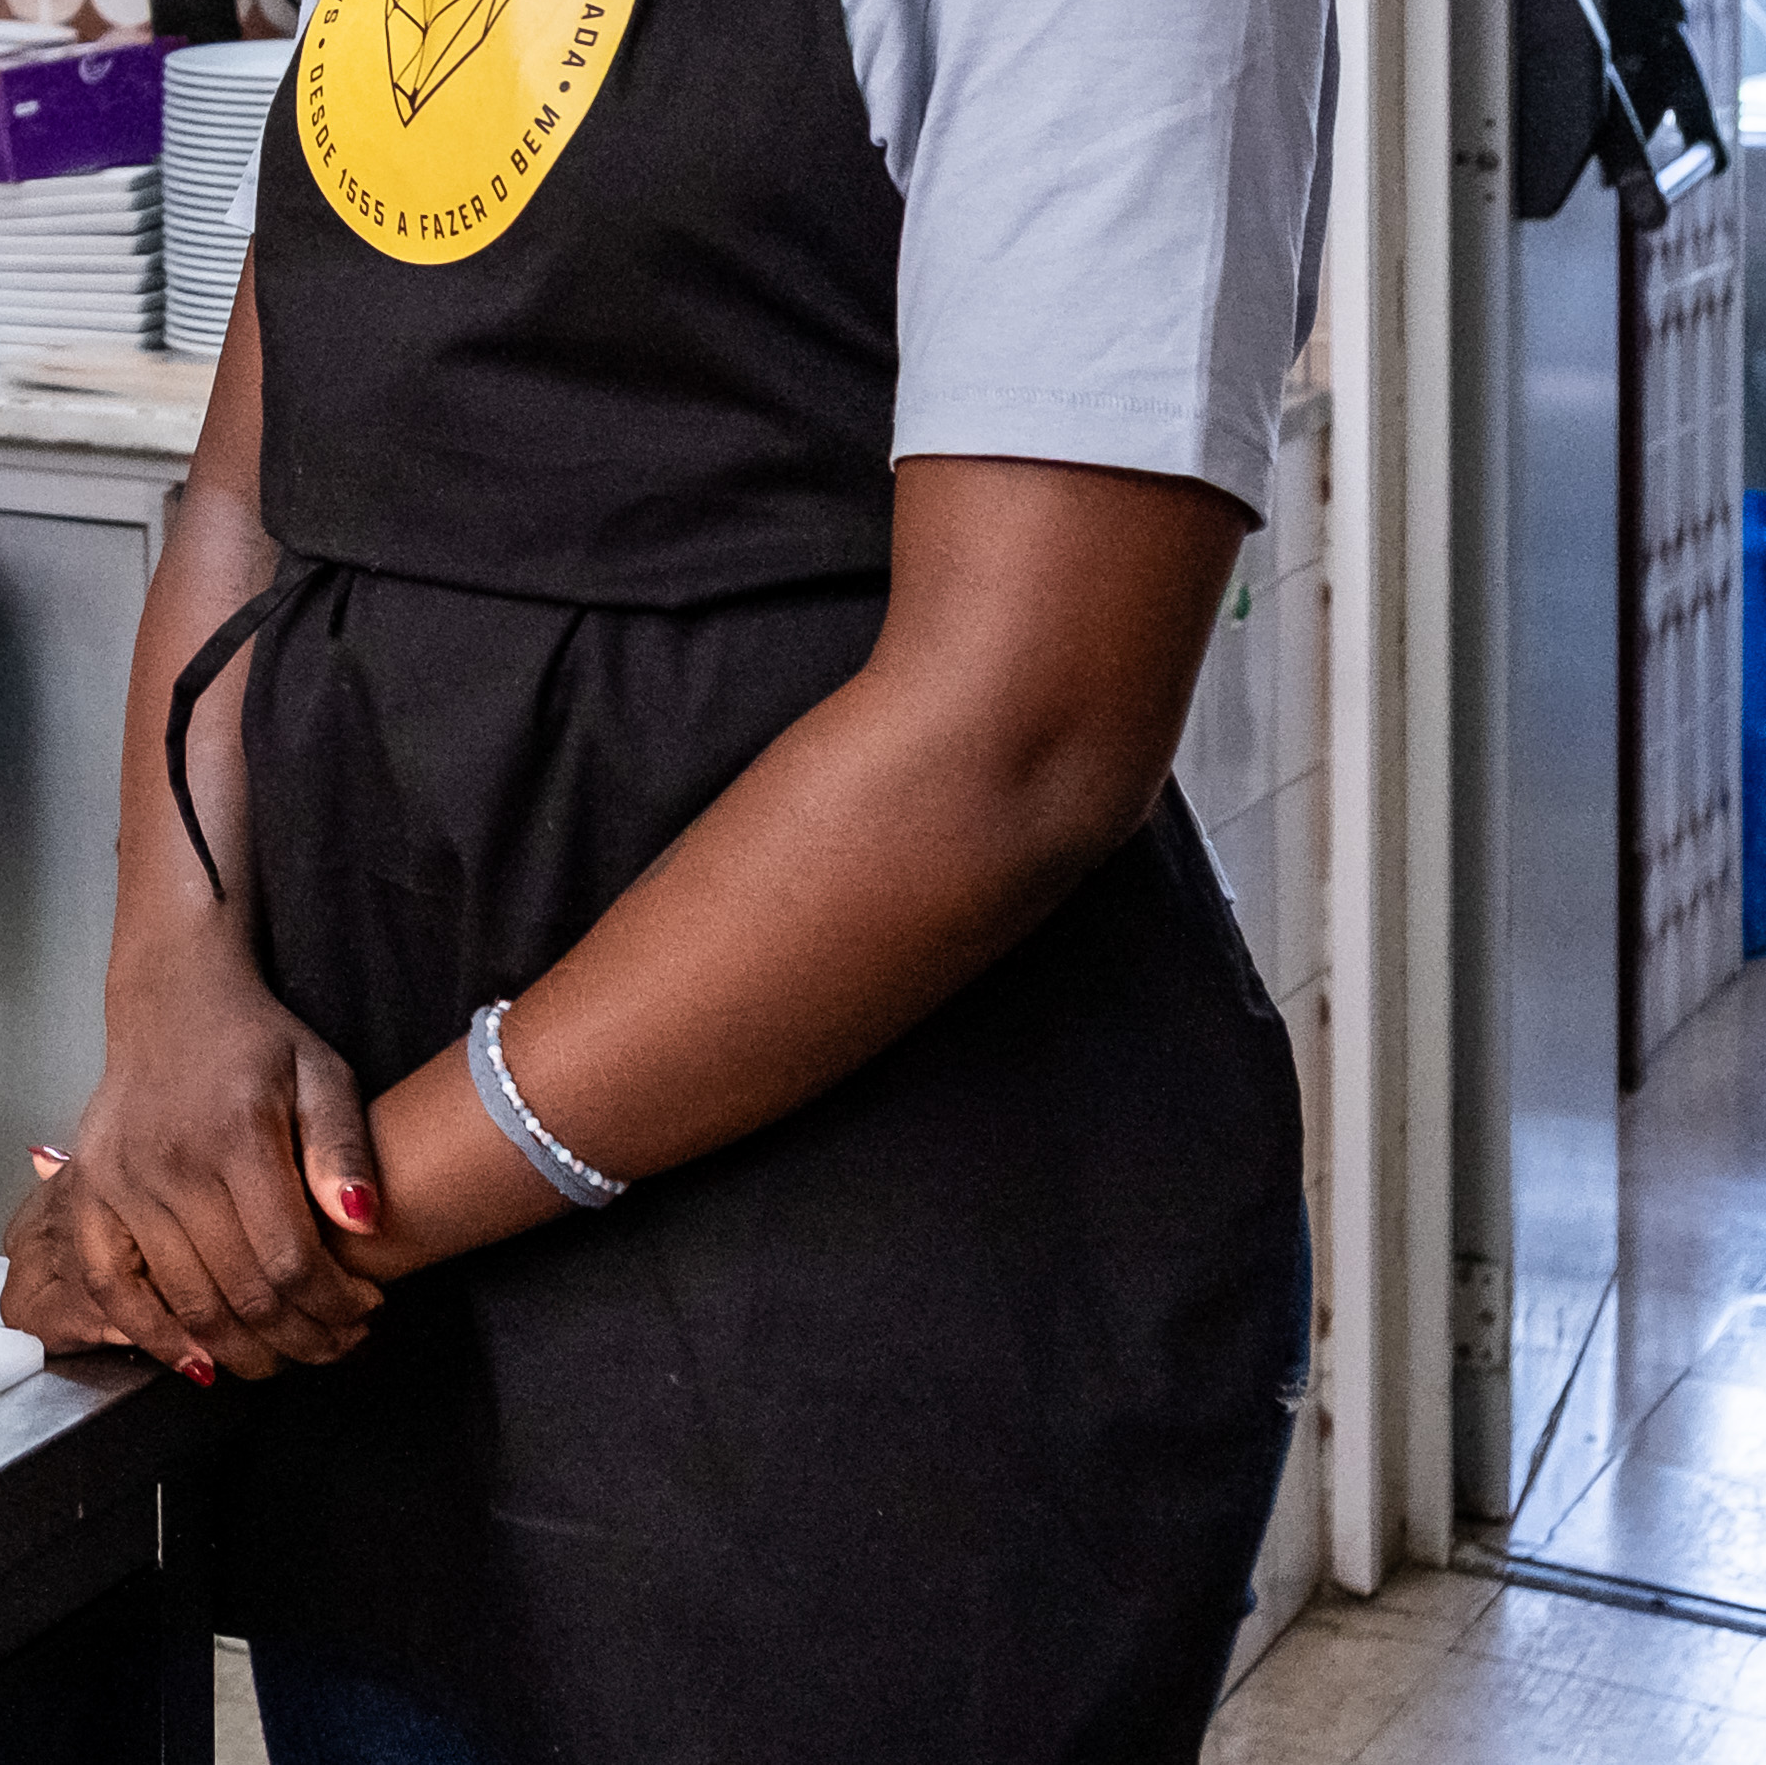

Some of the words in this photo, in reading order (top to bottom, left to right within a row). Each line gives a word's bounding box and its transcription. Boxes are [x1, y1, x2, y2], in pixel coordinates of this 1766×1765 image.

[309, 63, 337, 169] DESDE
[338, 168, 385, 228] 1555
[397, 211, 408, 237] A
[420, 194, 488, 241] FAZER
[491, 174, 508, 203] O
[509, 103, 561, 176] BEM
